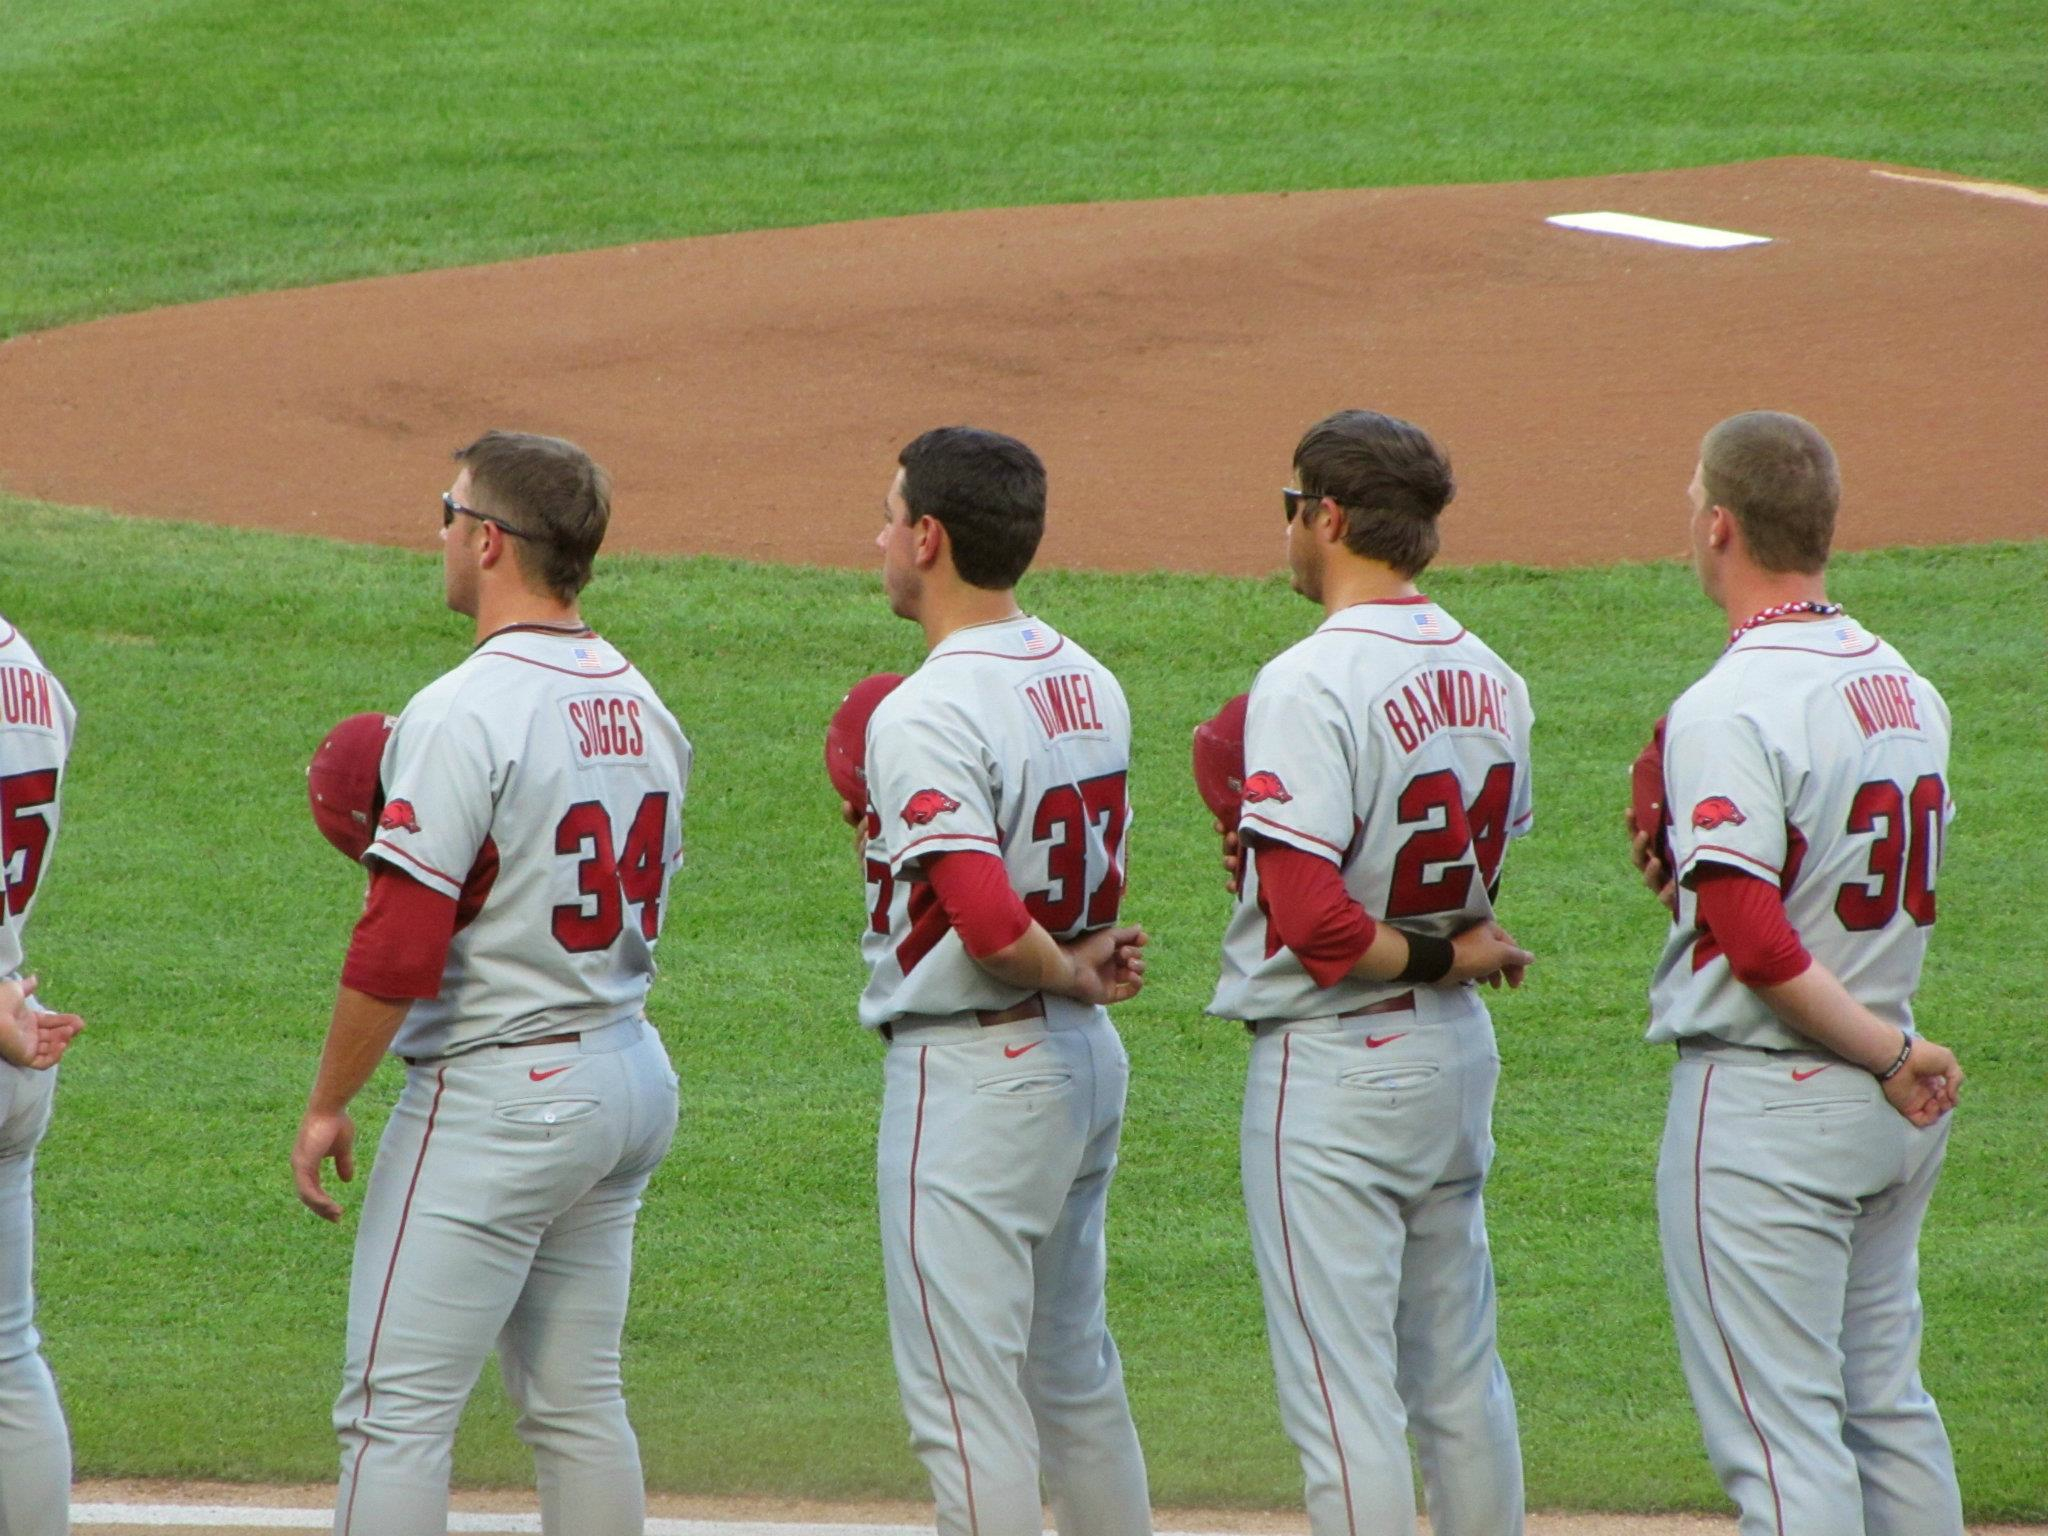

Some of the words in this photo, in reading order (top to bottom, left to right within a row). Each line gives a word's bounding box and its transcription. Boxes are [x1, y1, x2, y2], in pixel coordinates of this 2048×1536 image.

[0, 667, 53, 729] URN
[1025, 674, 1104, 740] DNIEL
[1384, 670, 1512, 754] BAXNDAL
[1844, 674, 1921, 739] MOORE
[0, 768, 58, 926] 5
[552, 791, 669, 953] 34
[1023, 770, 1128, 933] 37
[1385, 762, 1515, 919] 24
[1835, 772, 1945, 932] 30
